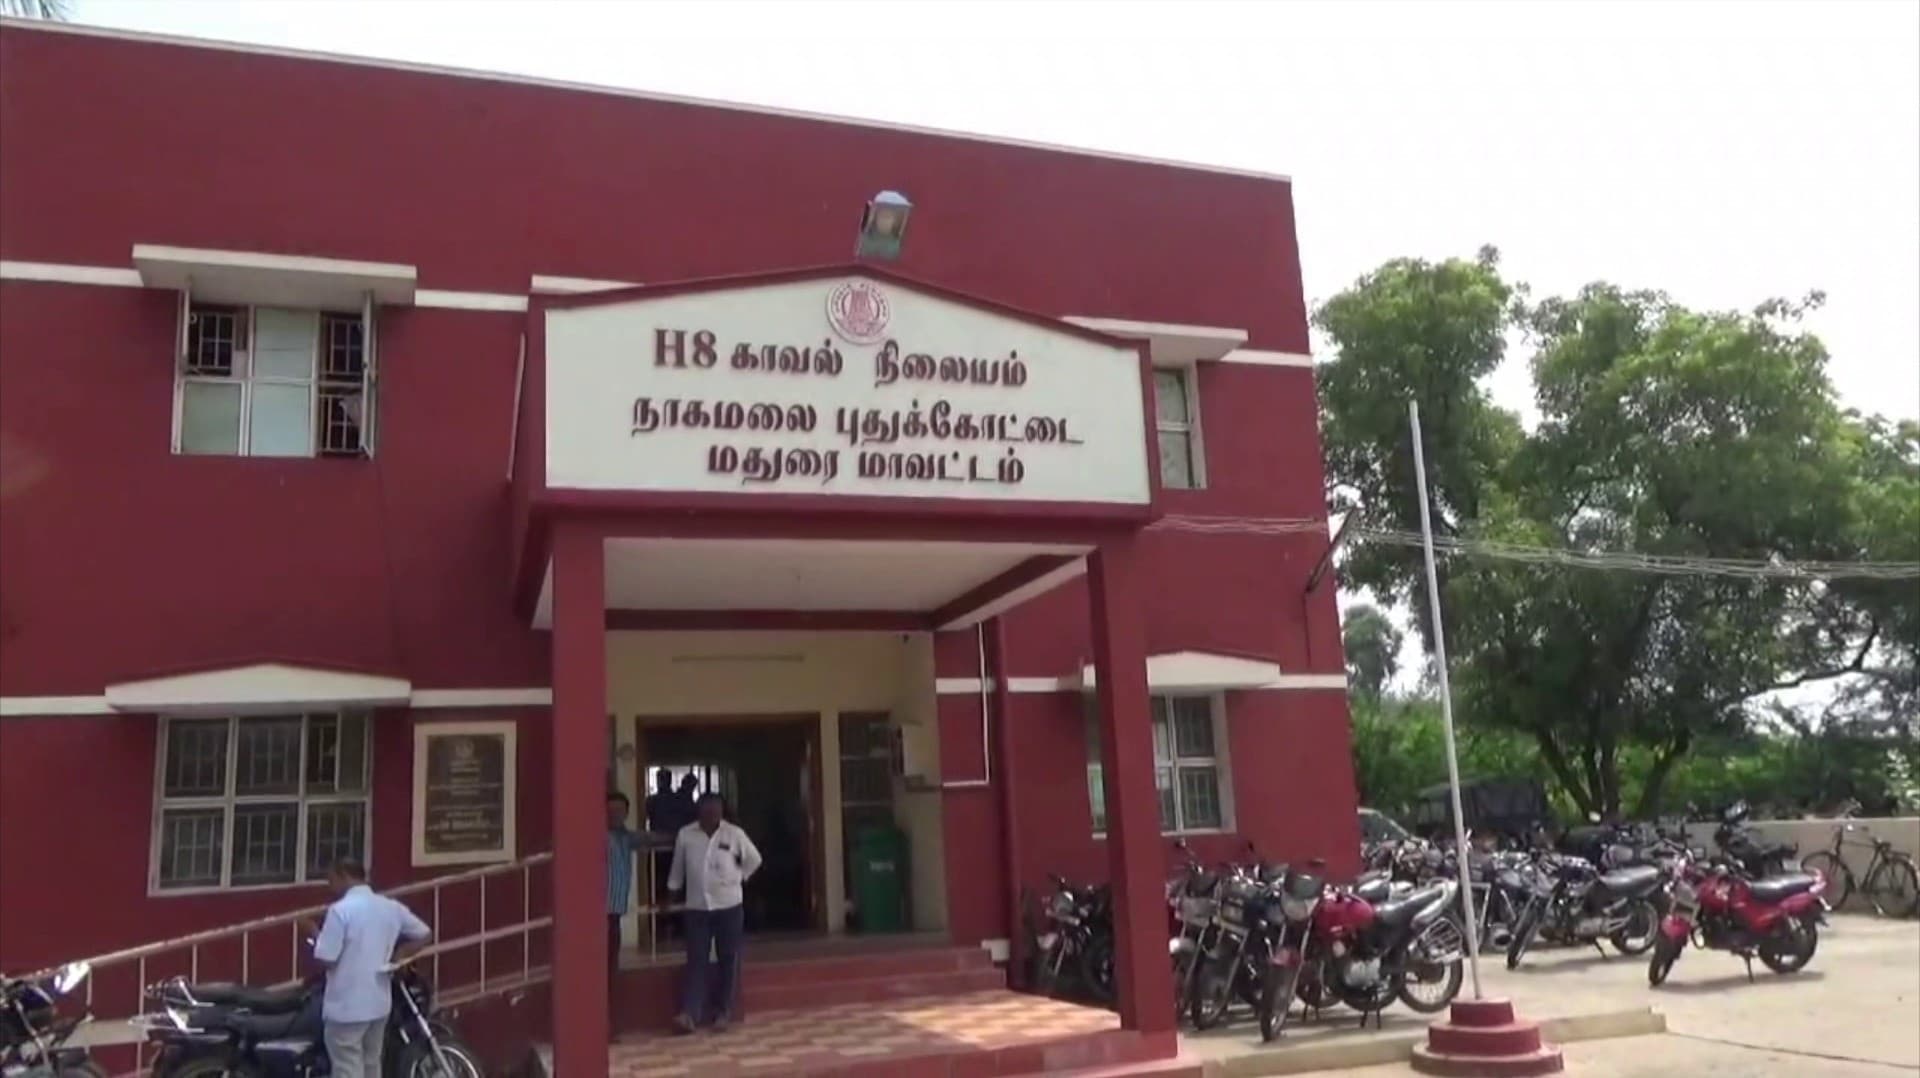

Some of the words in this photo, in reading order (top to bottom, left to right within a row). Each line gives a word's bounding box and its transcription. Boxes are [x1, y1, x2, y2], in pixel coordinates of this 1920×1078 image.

[654, 328, 718, 369] H8
[731, 338, 844, 377] காவல்
[874, 339, 1027, 388] நிலையம்
[631, 397, 817, 437] நாகமலை
[836, 400, 1084, 447] புதுக்கோட்டை
[707, 445, 840, 486] மதுரை
[858, 447, 1025, 485] மாவட்டம்
